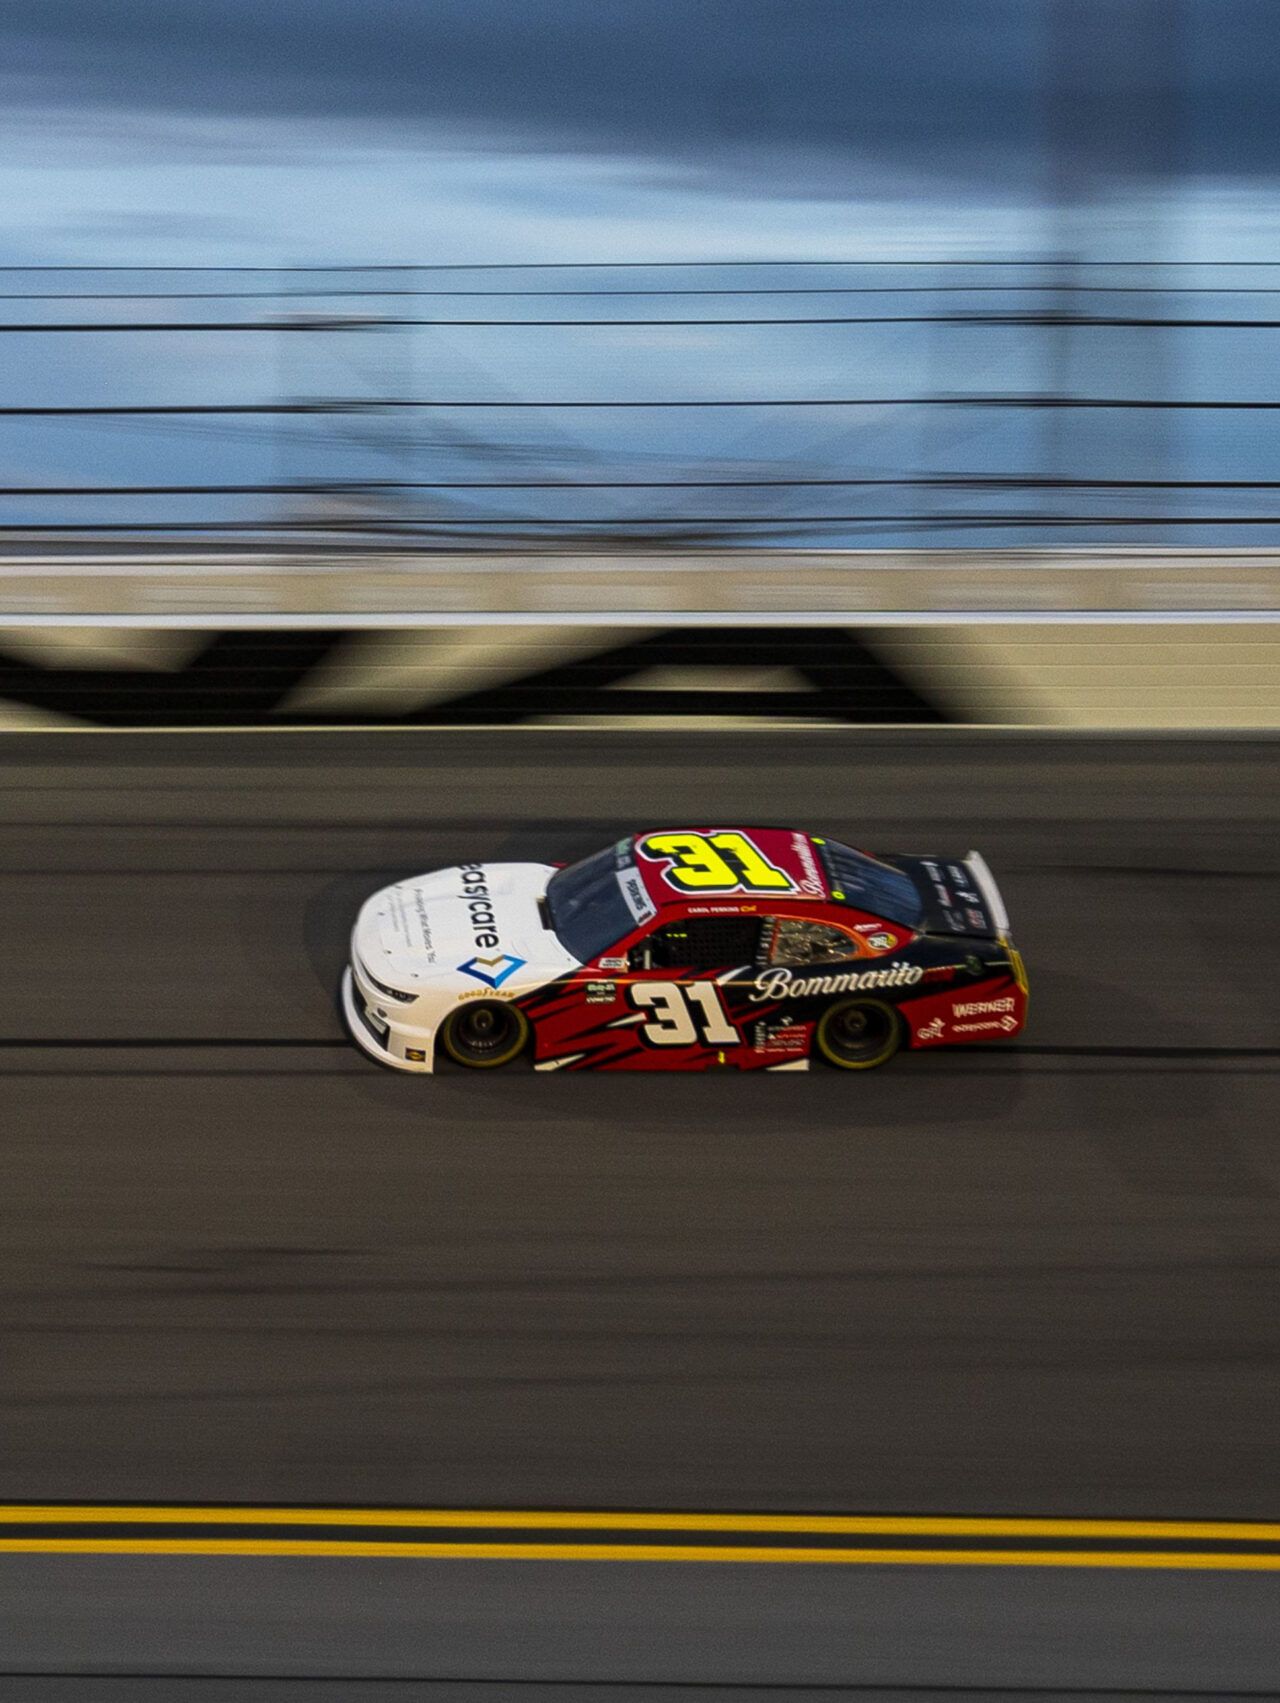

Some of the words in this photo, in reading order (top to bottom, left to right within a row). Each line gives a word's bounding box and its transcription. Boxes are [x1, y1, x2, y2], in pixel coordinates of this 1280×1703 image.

[645, 833, 791, 887] 31
[457, 986, 517, 1001] GOODYEAR
[749, 960, 924, 1002] Bommarito
[631, 981, 741, 1044] 31
